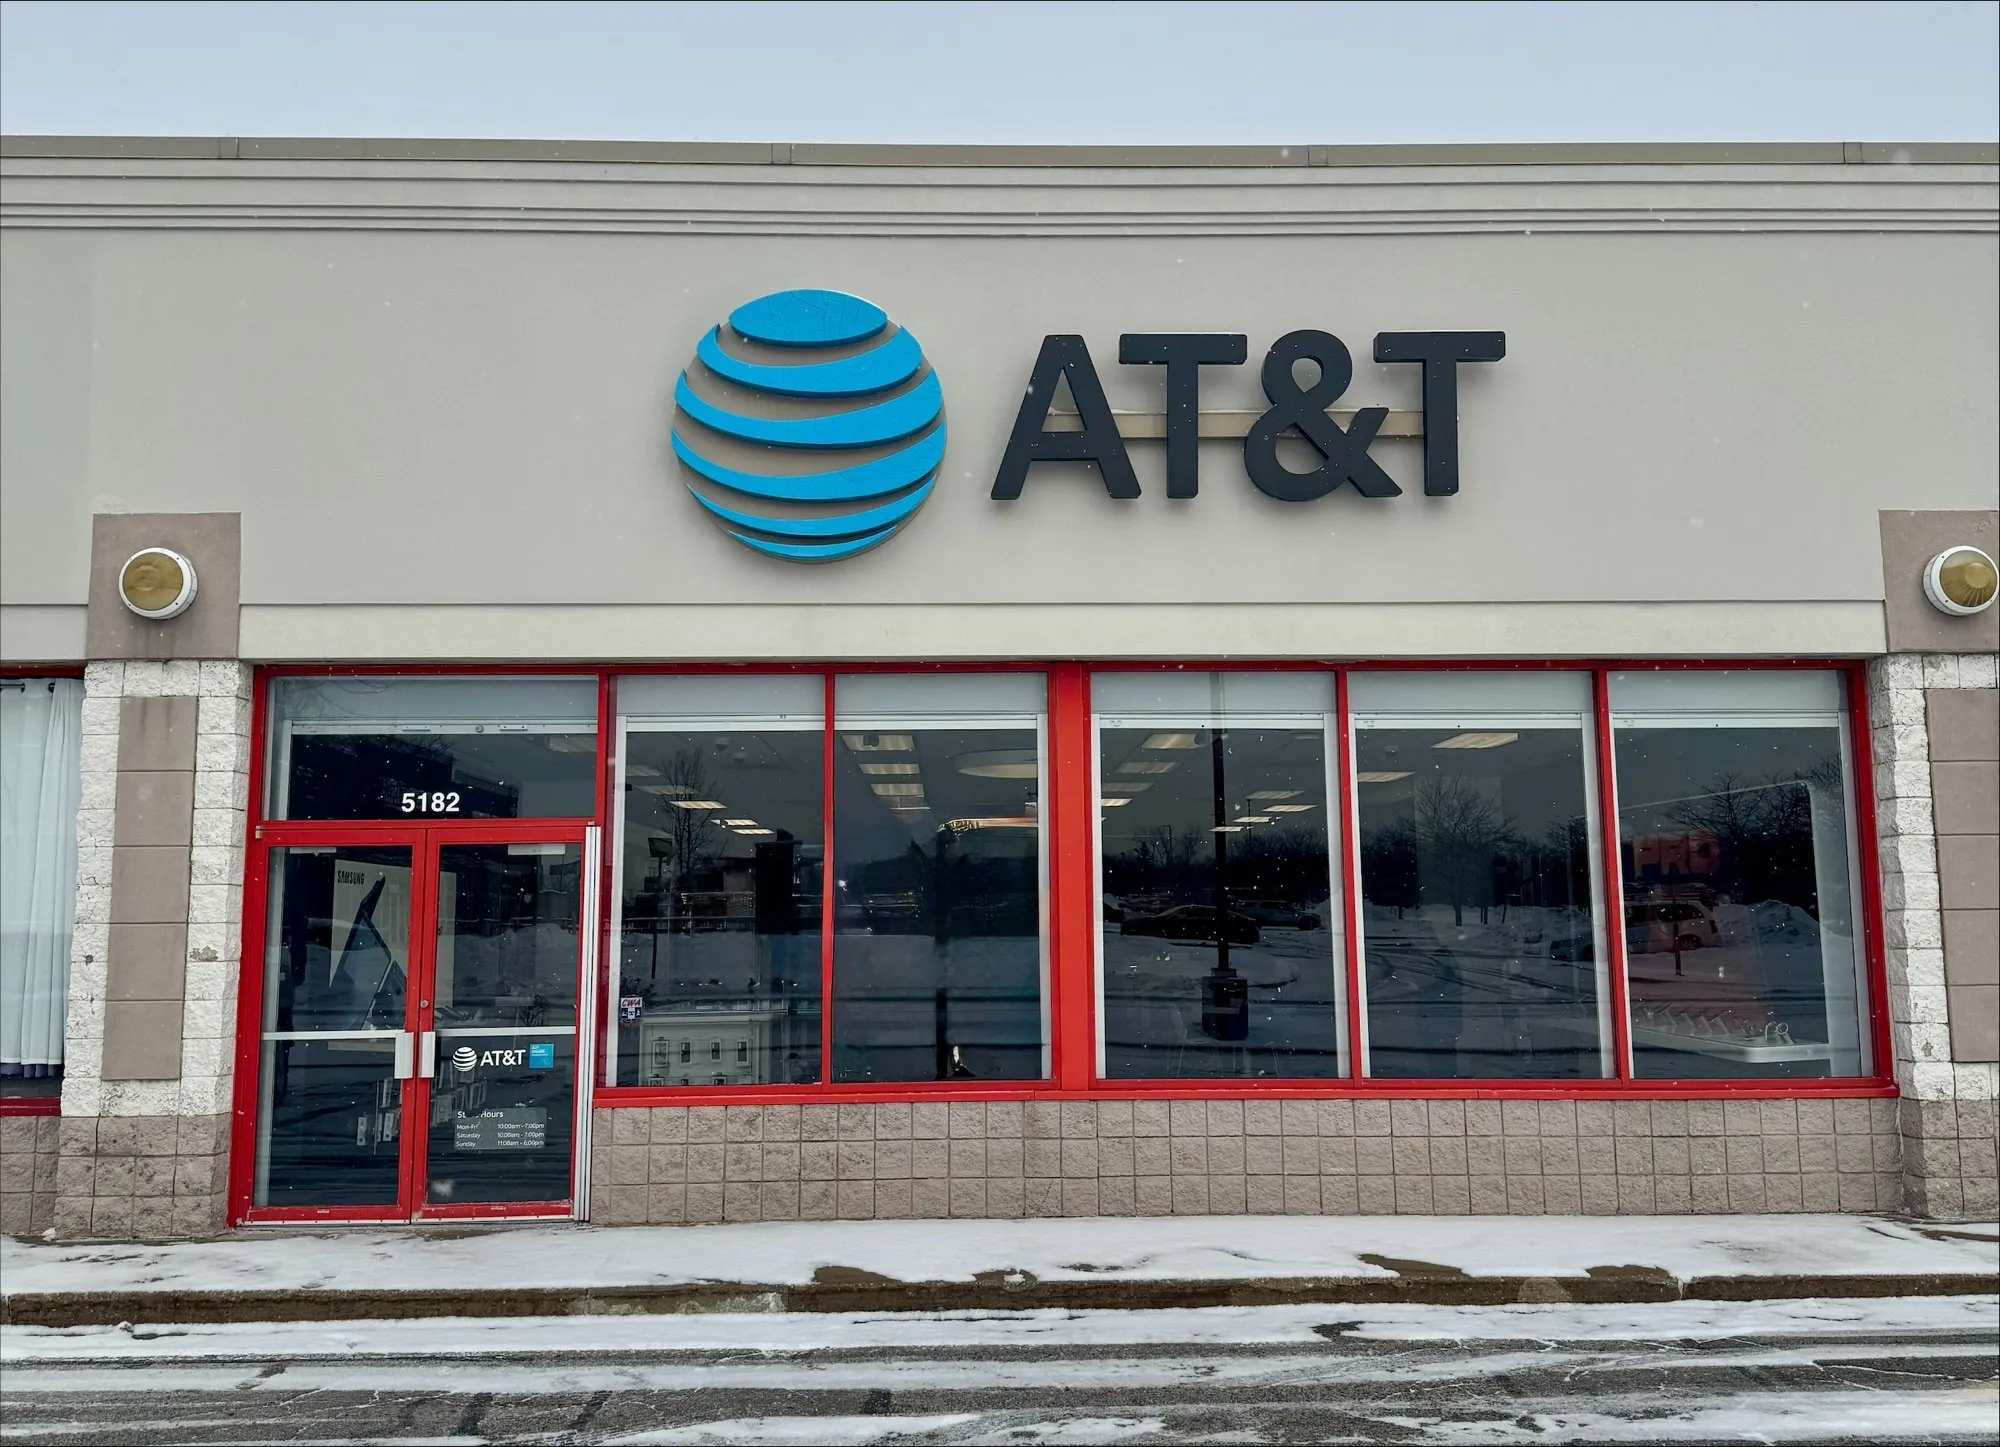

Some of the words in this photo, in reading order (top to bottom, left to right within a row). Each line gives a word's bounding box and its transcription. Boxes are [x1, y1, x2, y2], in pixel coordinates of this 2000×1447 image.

[990, 329, 1507, 502] AT&T
[401, 792, 460, 813] 5182
[337, 870, 365, 885] SAMSUNG
[621, 998, 641, 1007] CWA
[480, 1049, 526, 1067] AT&T
